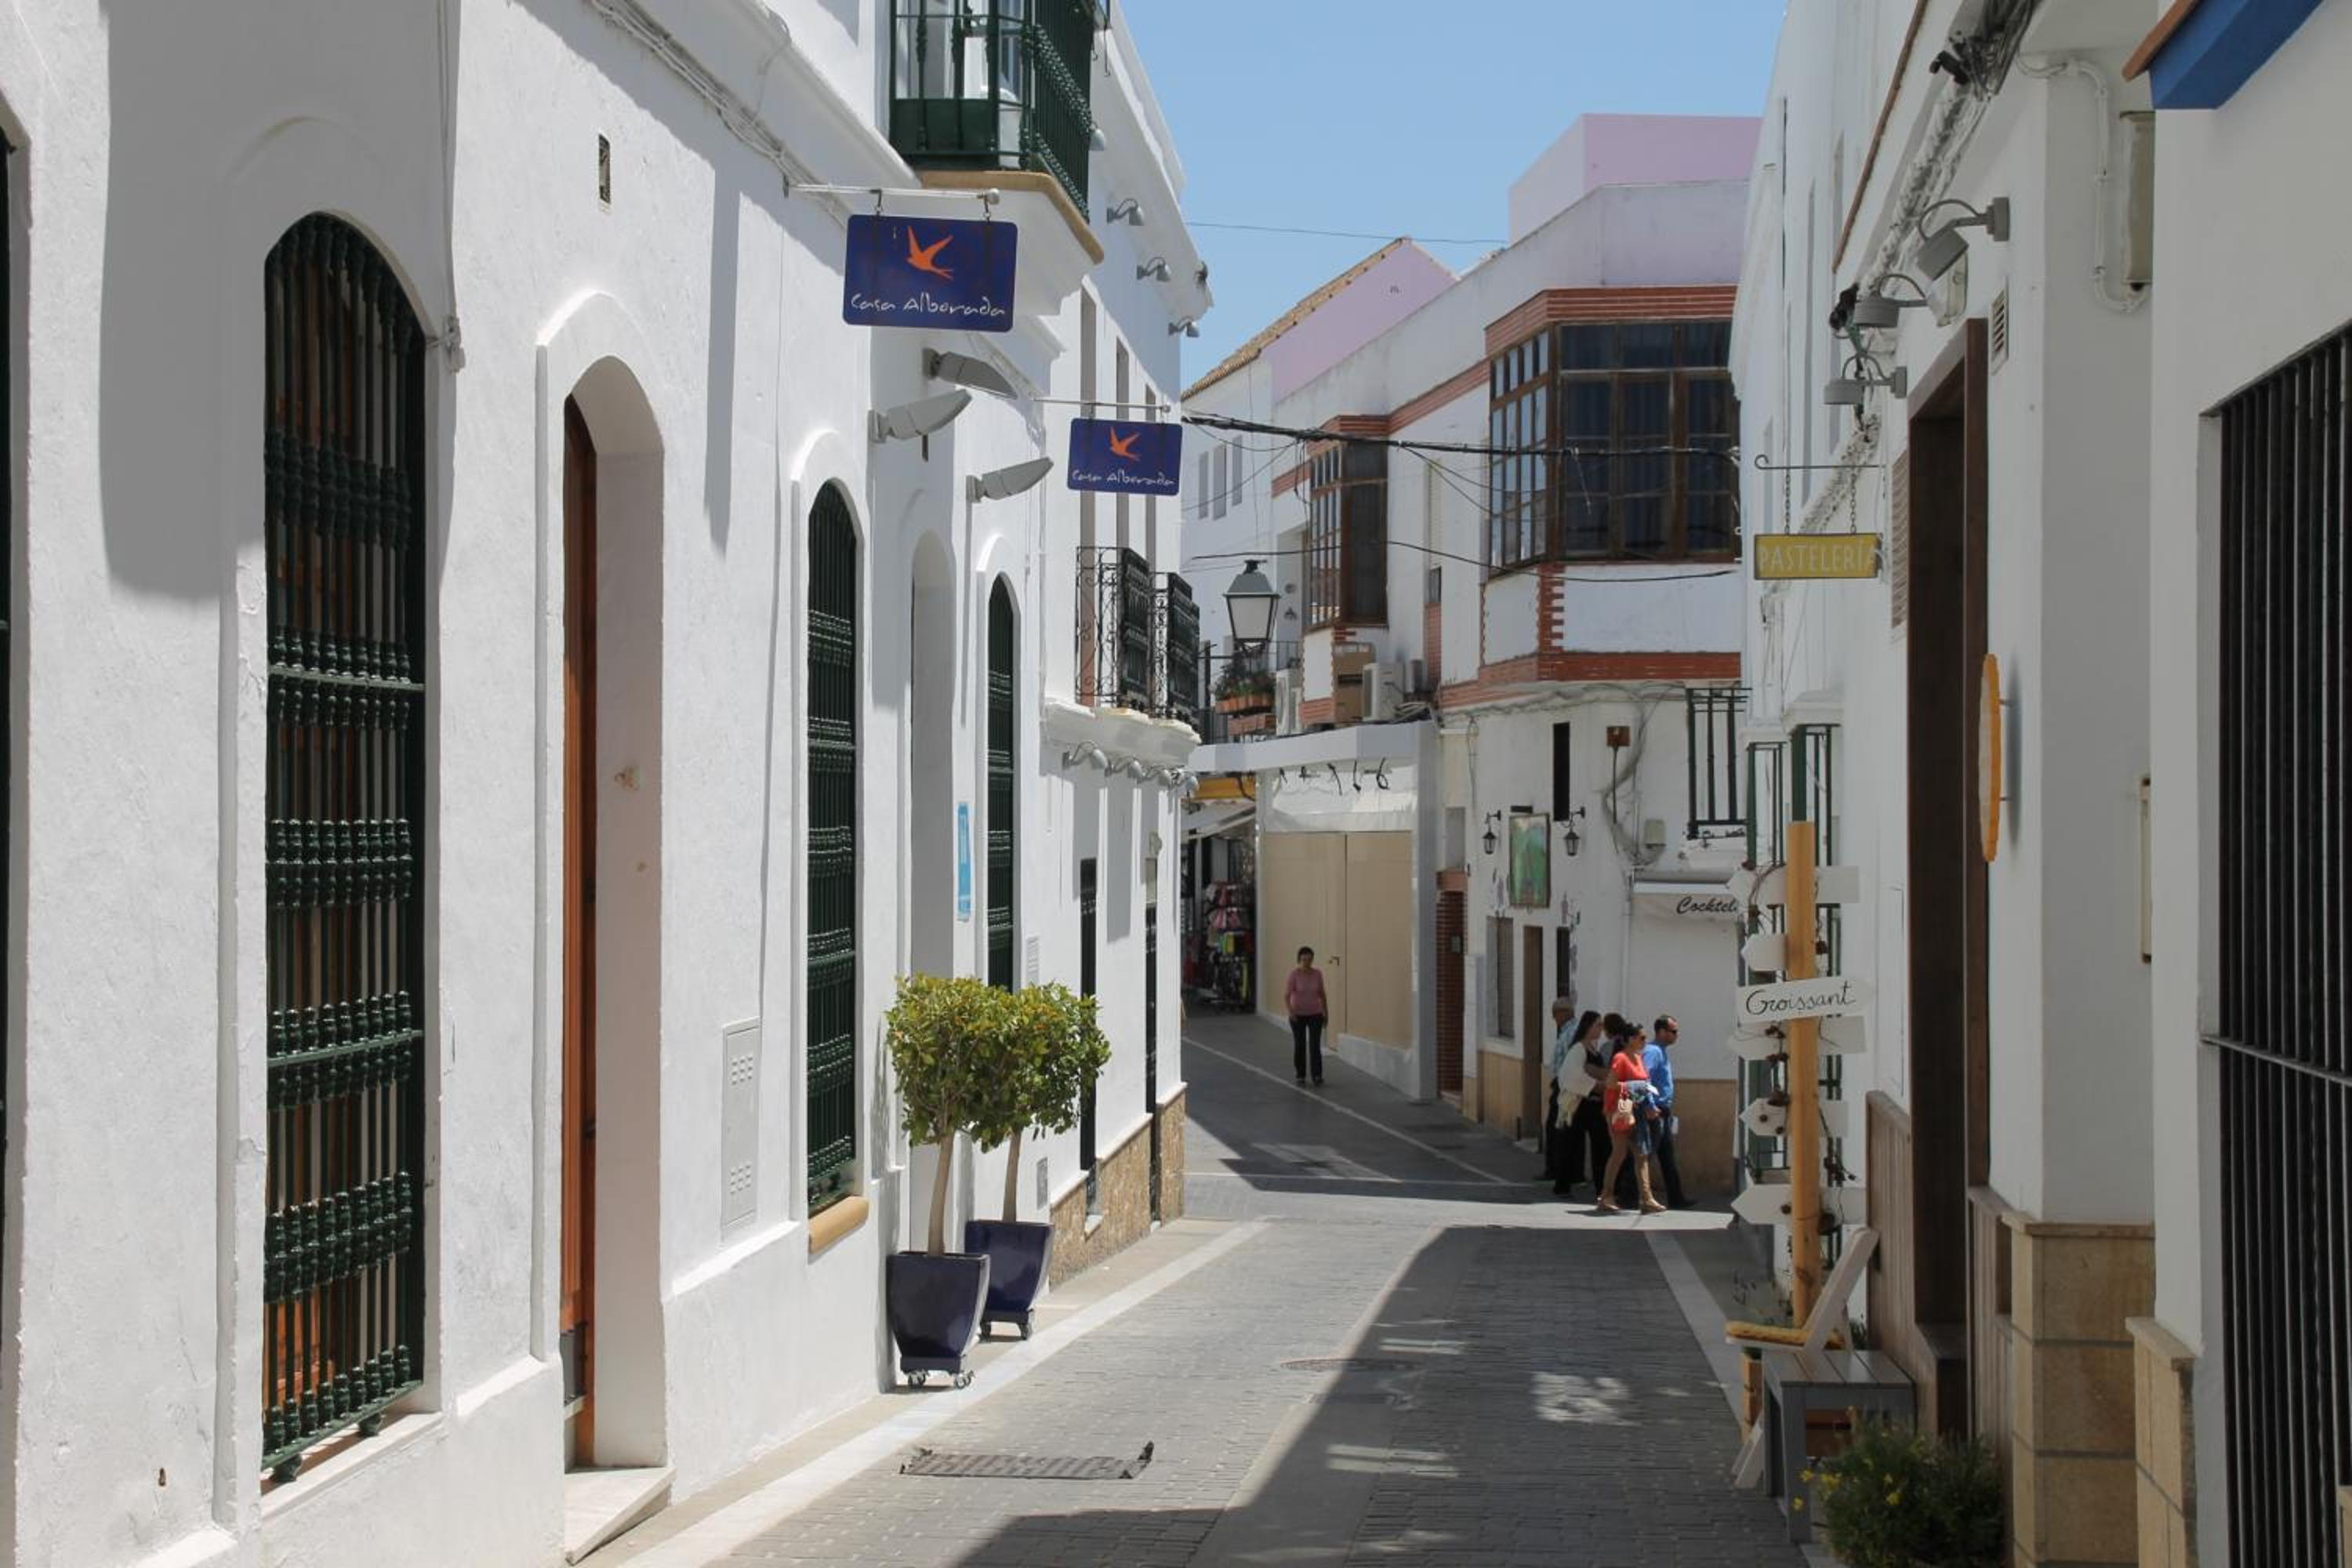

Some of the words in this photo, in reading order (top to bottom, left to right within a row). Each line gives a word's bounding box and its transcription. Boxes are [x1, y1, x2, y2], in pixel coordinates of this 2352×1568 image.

[851, 293, 896, 311] Casa
[903, 292, 1006, 316] Alborada
[1072, 470, 1102, 481] Casa
